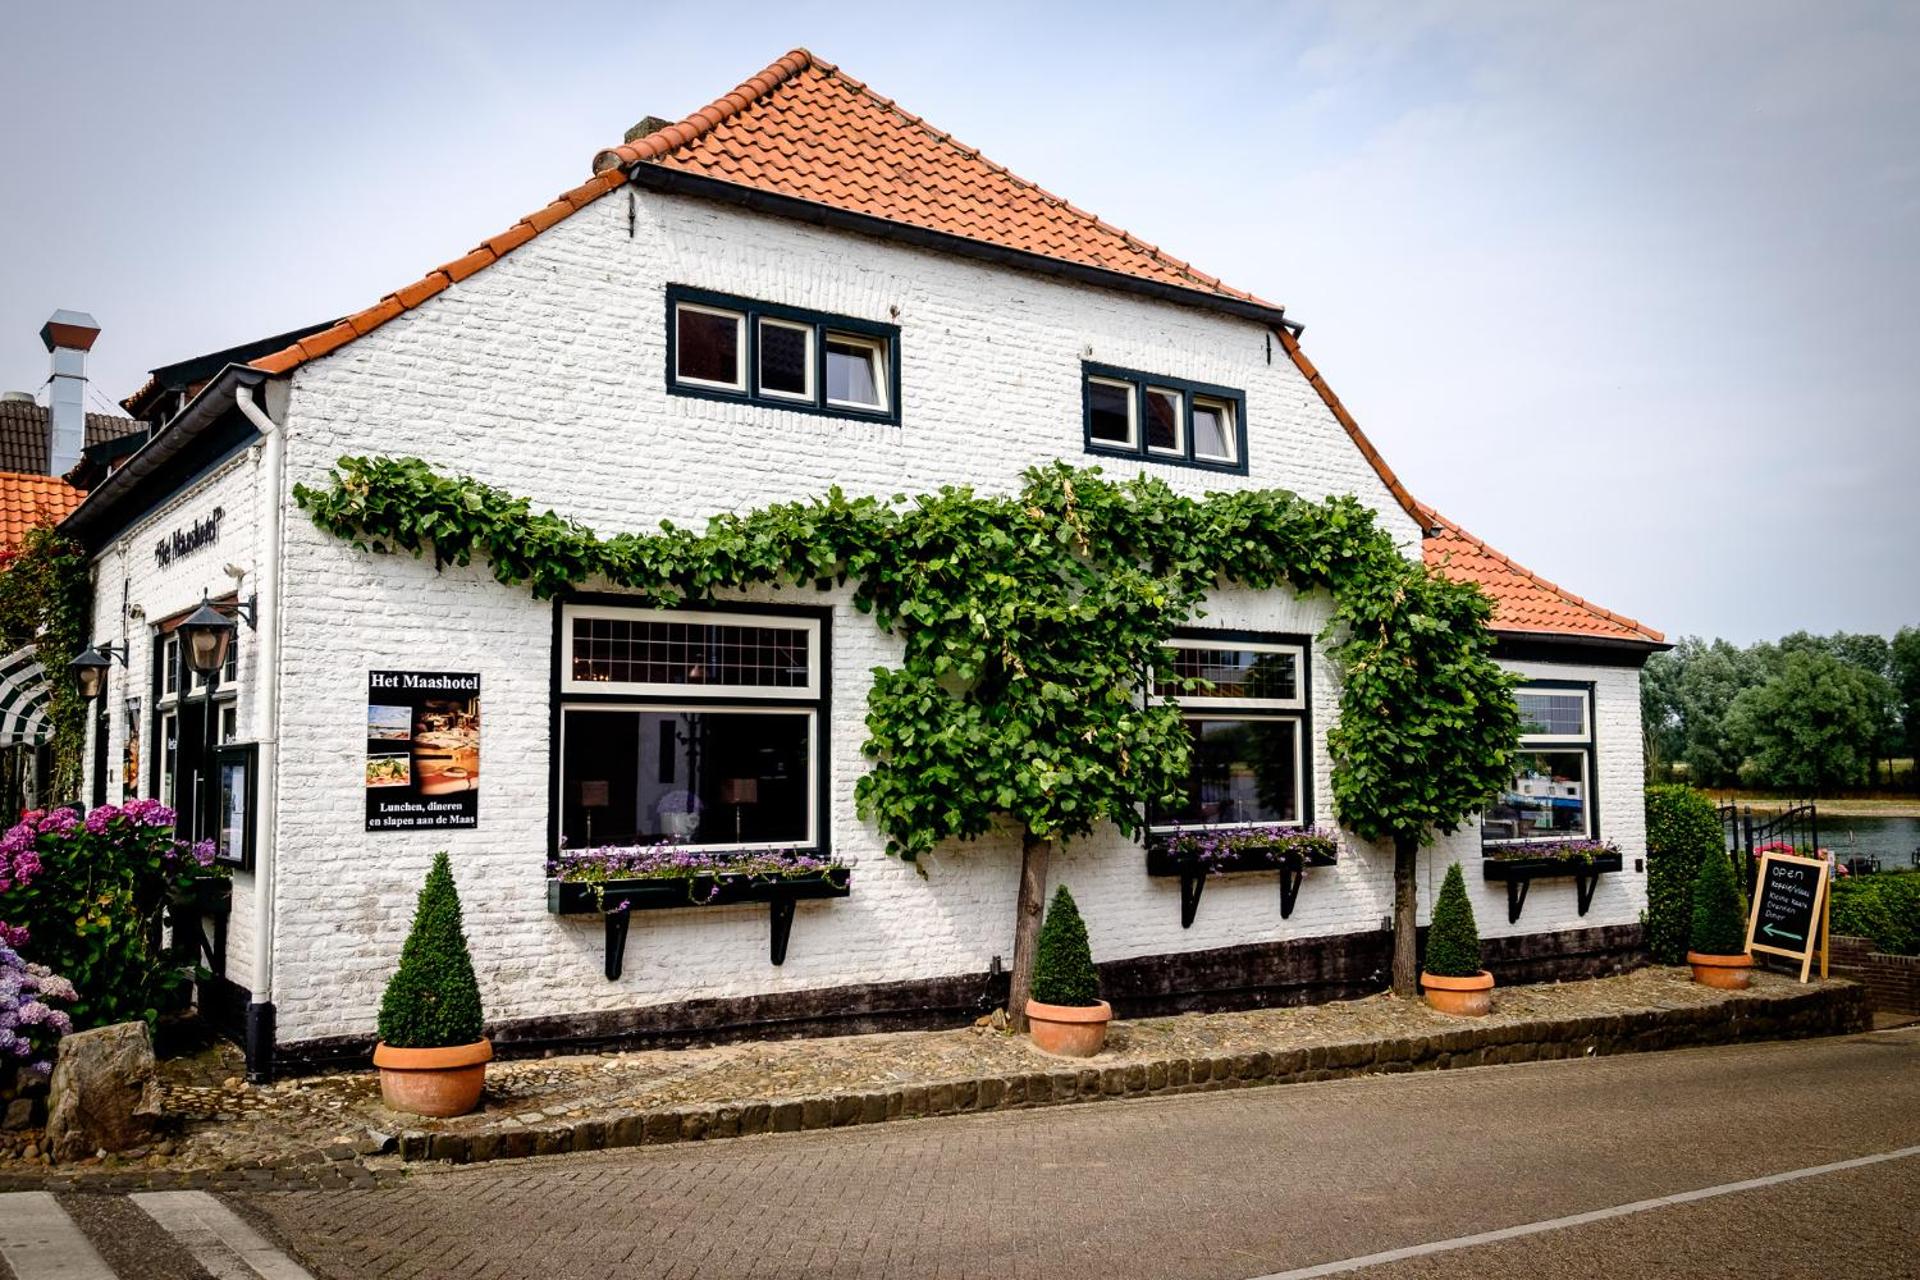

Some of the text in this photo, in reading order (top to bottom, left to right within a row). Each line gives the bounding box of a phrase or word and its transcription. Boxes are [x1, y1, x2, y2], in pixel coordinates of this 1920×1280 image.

[371, 674, 478, 690] Het Maashotel
[380, 801, 463, 813] Lunchen, dineren
[369, 815, 475, 828] en slapen aan de Maas
